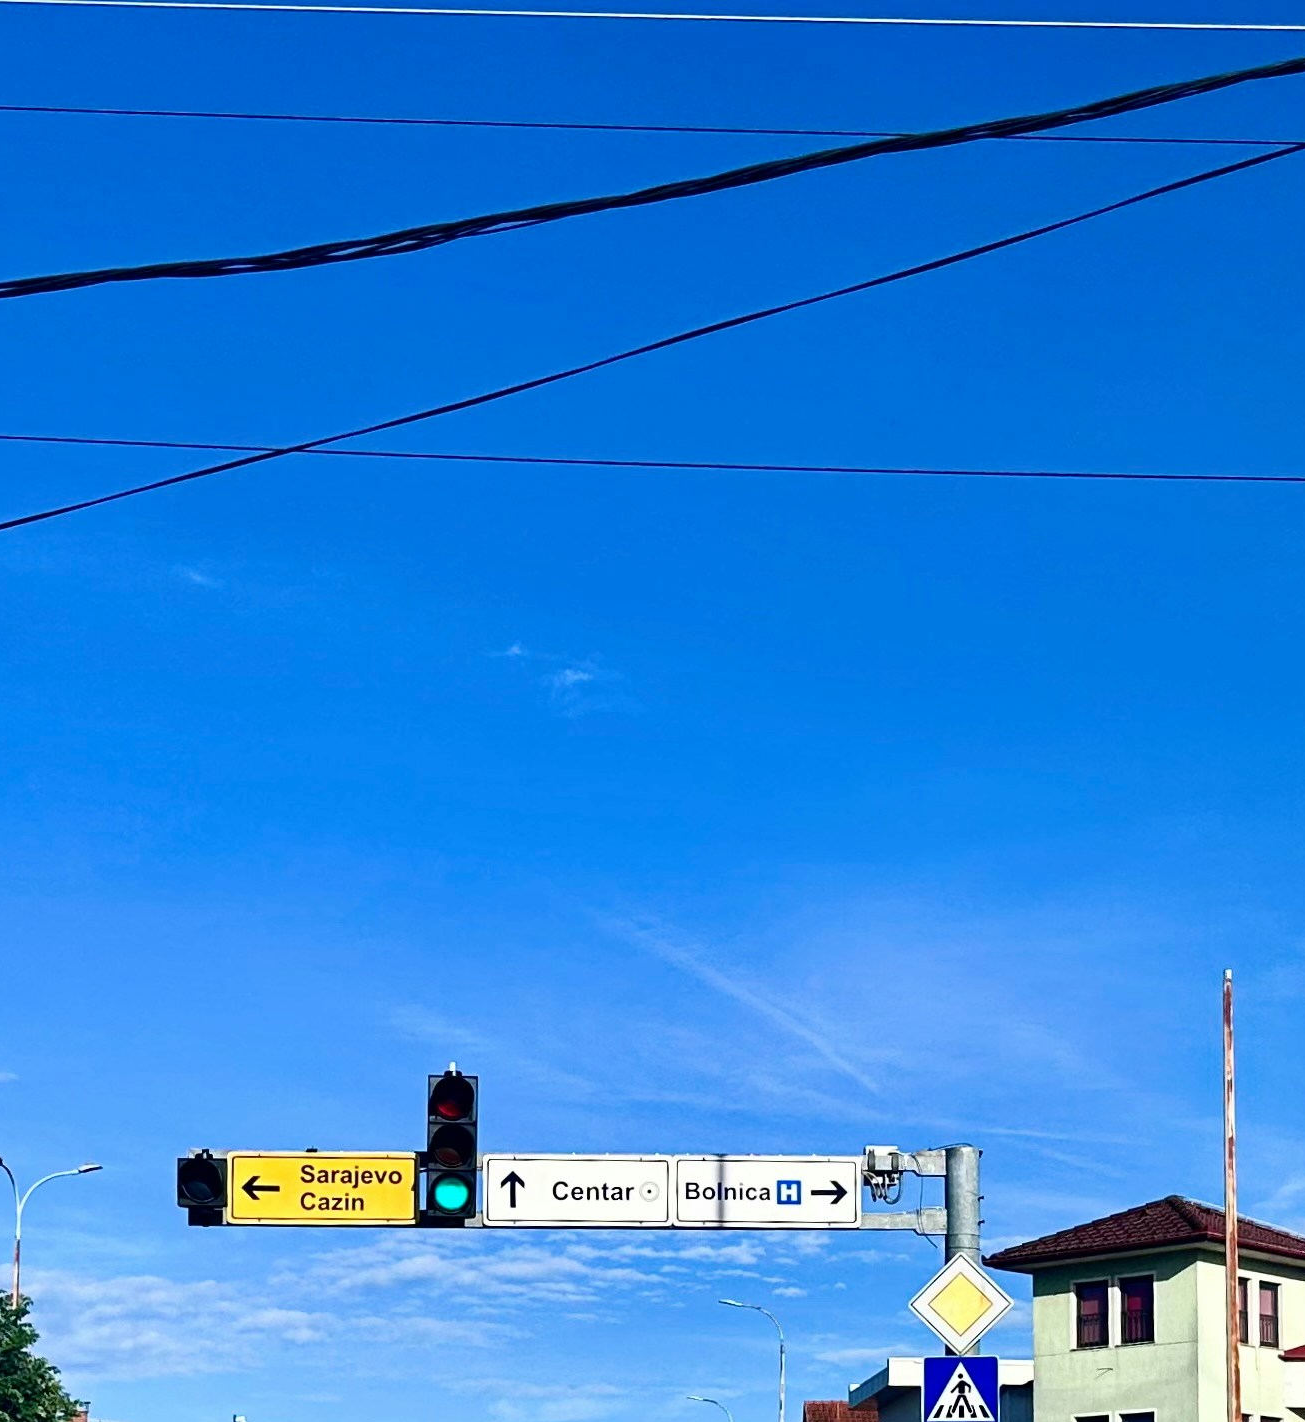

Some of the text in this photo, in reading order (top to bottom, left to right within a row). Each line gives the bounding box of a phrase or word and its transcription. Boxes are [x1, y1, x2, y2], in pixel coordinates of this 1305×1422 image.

[300, 1164, 403, 1189] Sarajevo
[551, 1181, 636, 1201] Centar
[684, 1181, 772, 1202] Bolnica
[300, 1192, 364, 1211] Cazin
